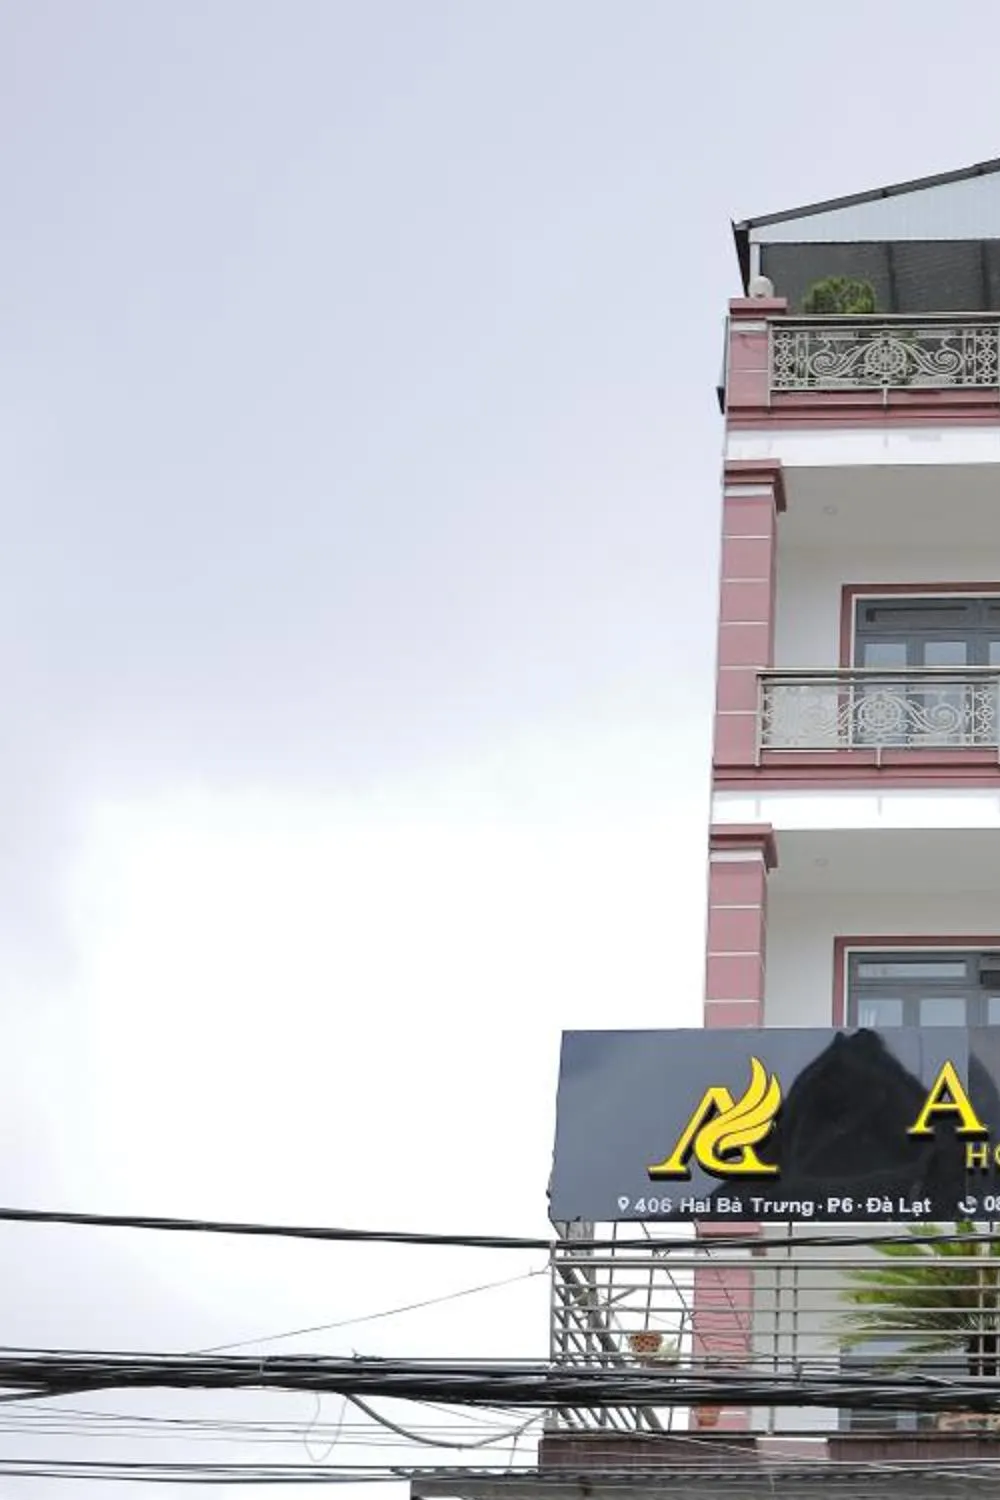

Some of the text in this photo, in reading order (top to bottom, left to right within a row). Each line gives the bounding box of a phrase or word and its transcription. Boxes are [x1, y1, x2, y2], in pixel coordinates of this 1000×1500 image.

[634, 1197, 673, 1213] 406
[750, 1197, 815, 1217] Trưng
[827, 1197, 853, 1213] P6
[866, 1195, 894, 1213] Đà
[899, 1197, 932, 1217] Lạt
